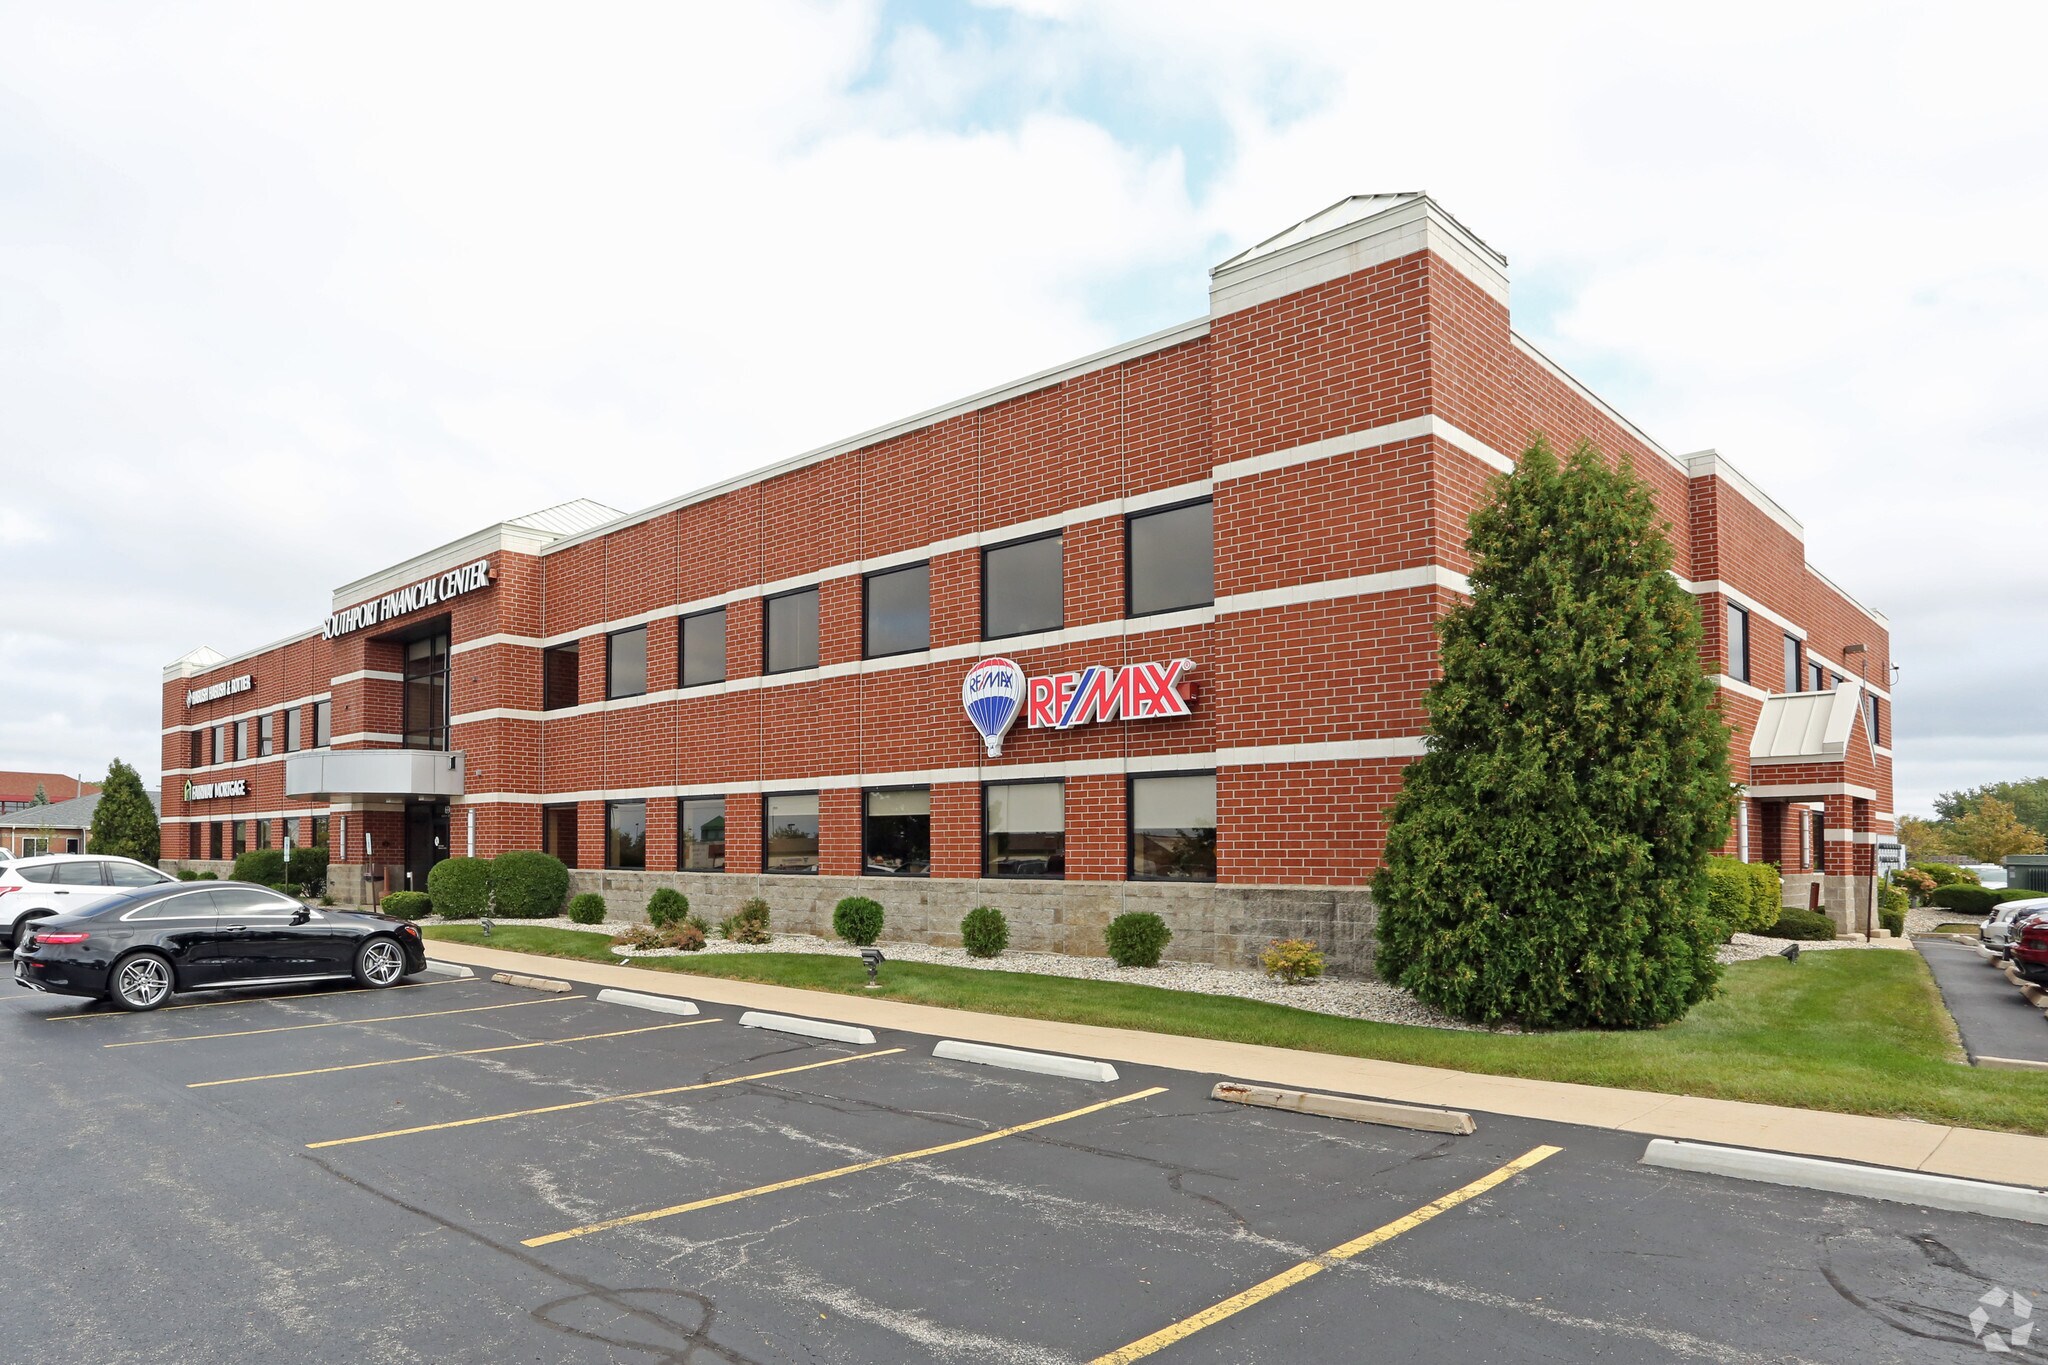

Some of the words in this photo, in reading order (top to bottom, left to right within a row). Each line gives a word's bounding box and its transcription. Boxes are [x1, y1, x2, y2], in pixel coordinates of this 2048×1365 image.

[322, 599, 380, 640] SOUTHPORT
[380, 578, 438, 621] FINANCIAL
[438, 559, 489, 601] CENTER
[970, 671, 1012, 692] RE/MAX
[1028, 660, 1190, 729] RE/MAX
[214, 780, 246, 797] MORTGAGE
